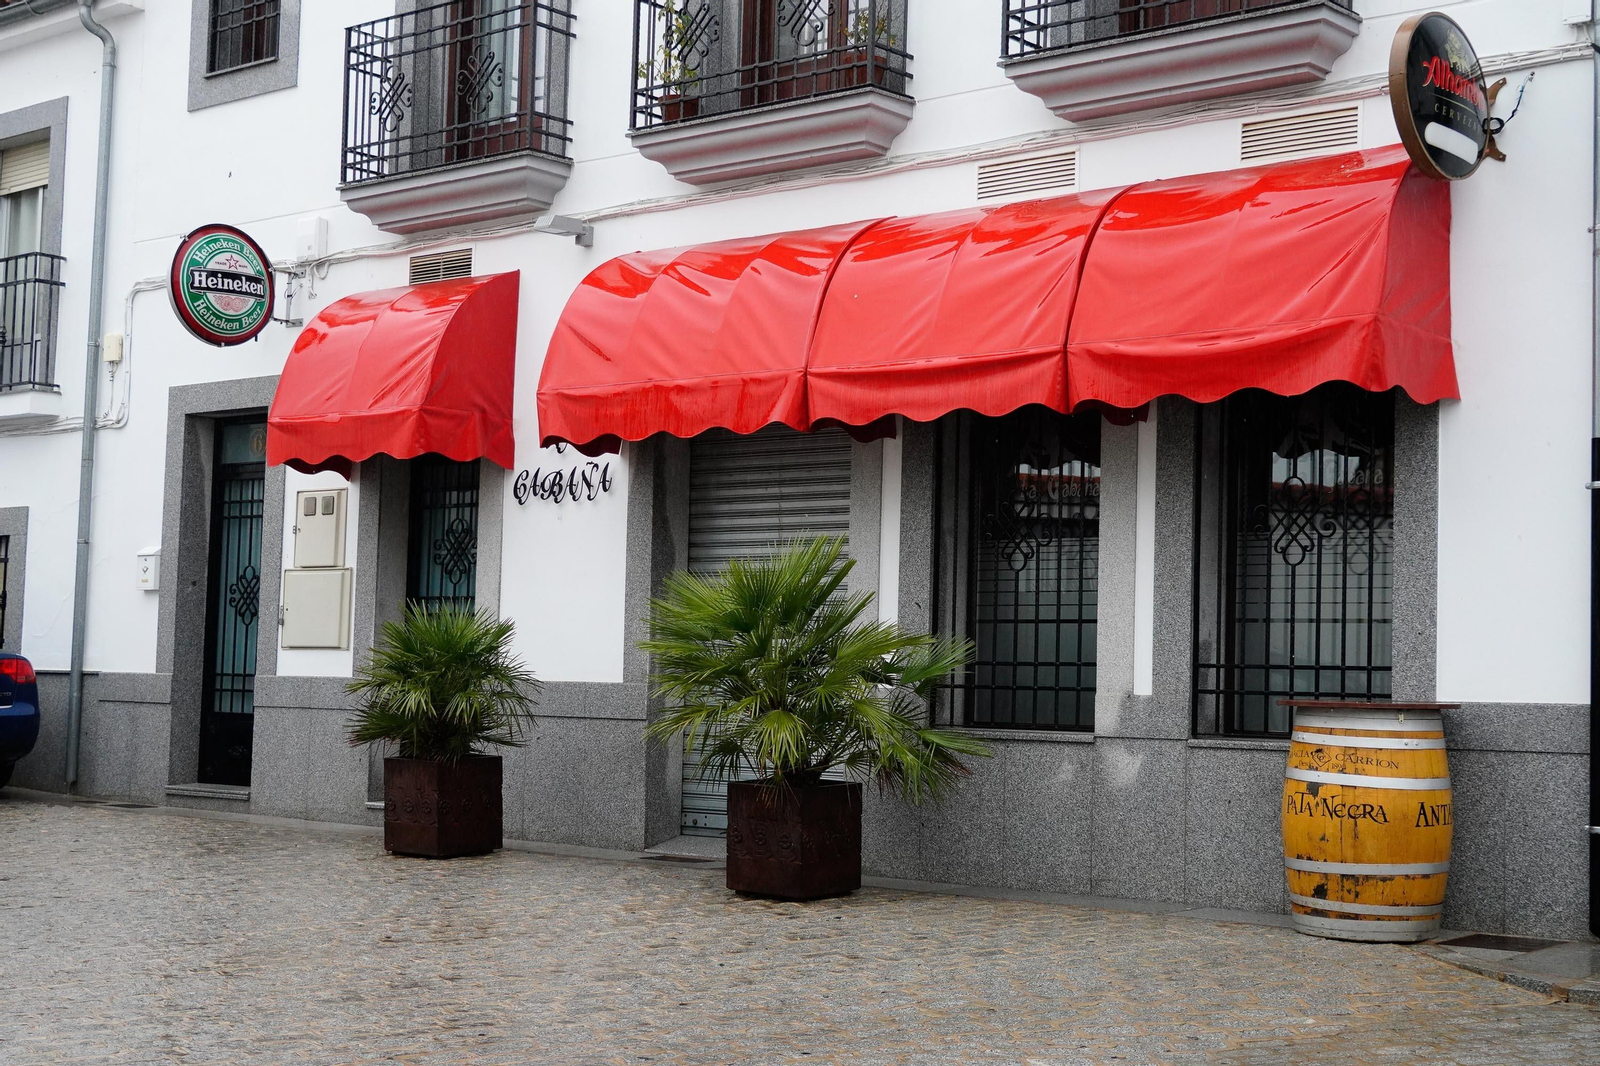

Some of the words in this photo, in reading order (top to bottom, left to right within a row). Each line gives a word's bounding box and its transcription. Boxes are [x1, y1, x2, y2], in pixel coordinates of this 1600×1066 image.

[193, 239, 241, 264] Heineken
[243, 247, 262, 272] Beer
[193, 271, 264, 296] Heineken
[194, 299, 240, 330] Heineken
[241, 306, 261, 328] Beer
[1335, 753, 1400, 770] CARRION
